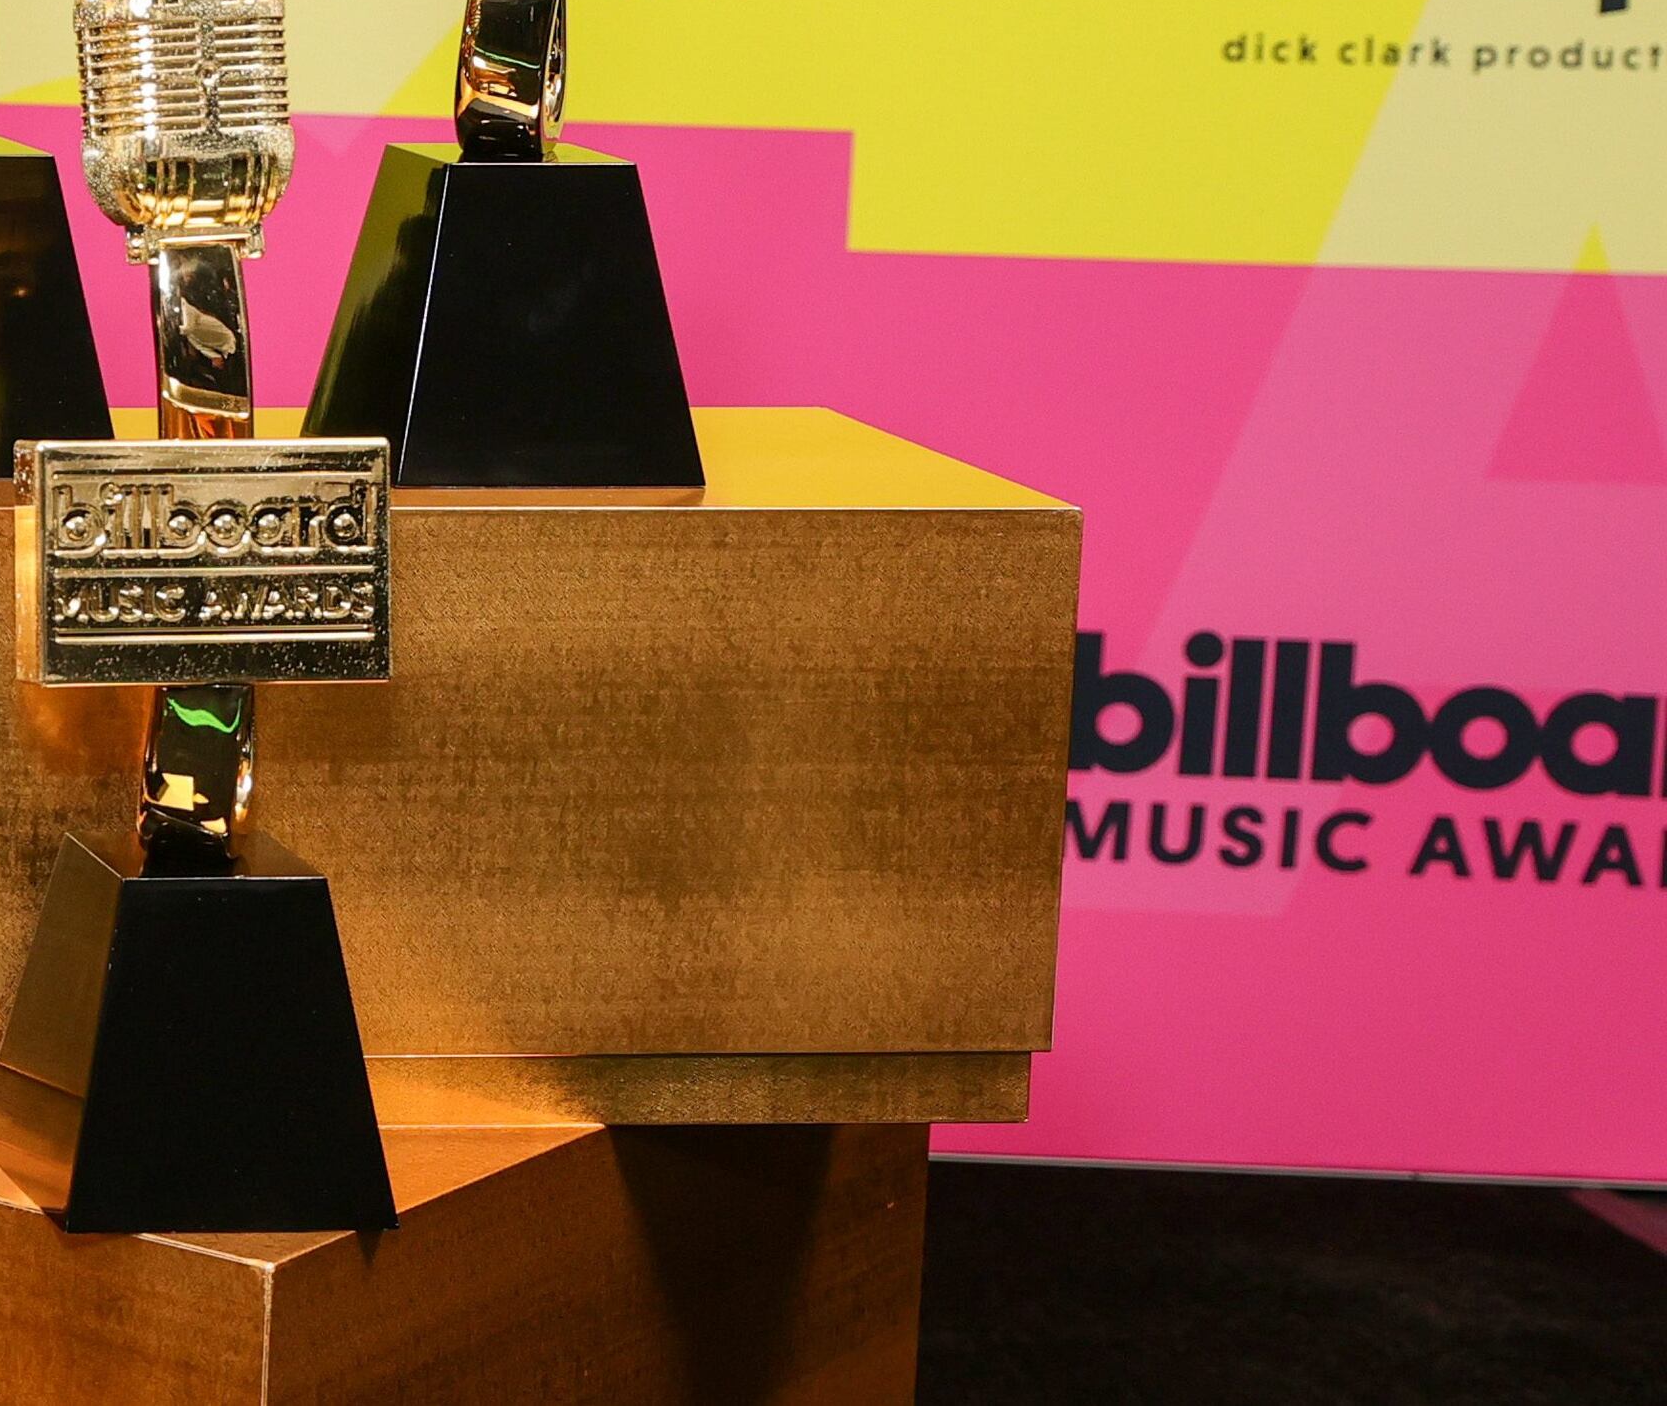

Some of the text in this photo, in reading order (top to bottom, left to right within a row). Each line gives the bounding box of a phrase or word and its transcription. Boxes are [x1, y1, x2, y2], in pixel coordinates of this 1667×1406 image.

[1220, 32, 1319, 65] dick
[1336, 36, 1452, 68] clark
[51, 481, 379, 558] billboard
[197, 581, 376, 622] AWARDS
[1067, 629, 1667, 798] billboa
[1066, 799, 1667, 888] MUSIC AWA
